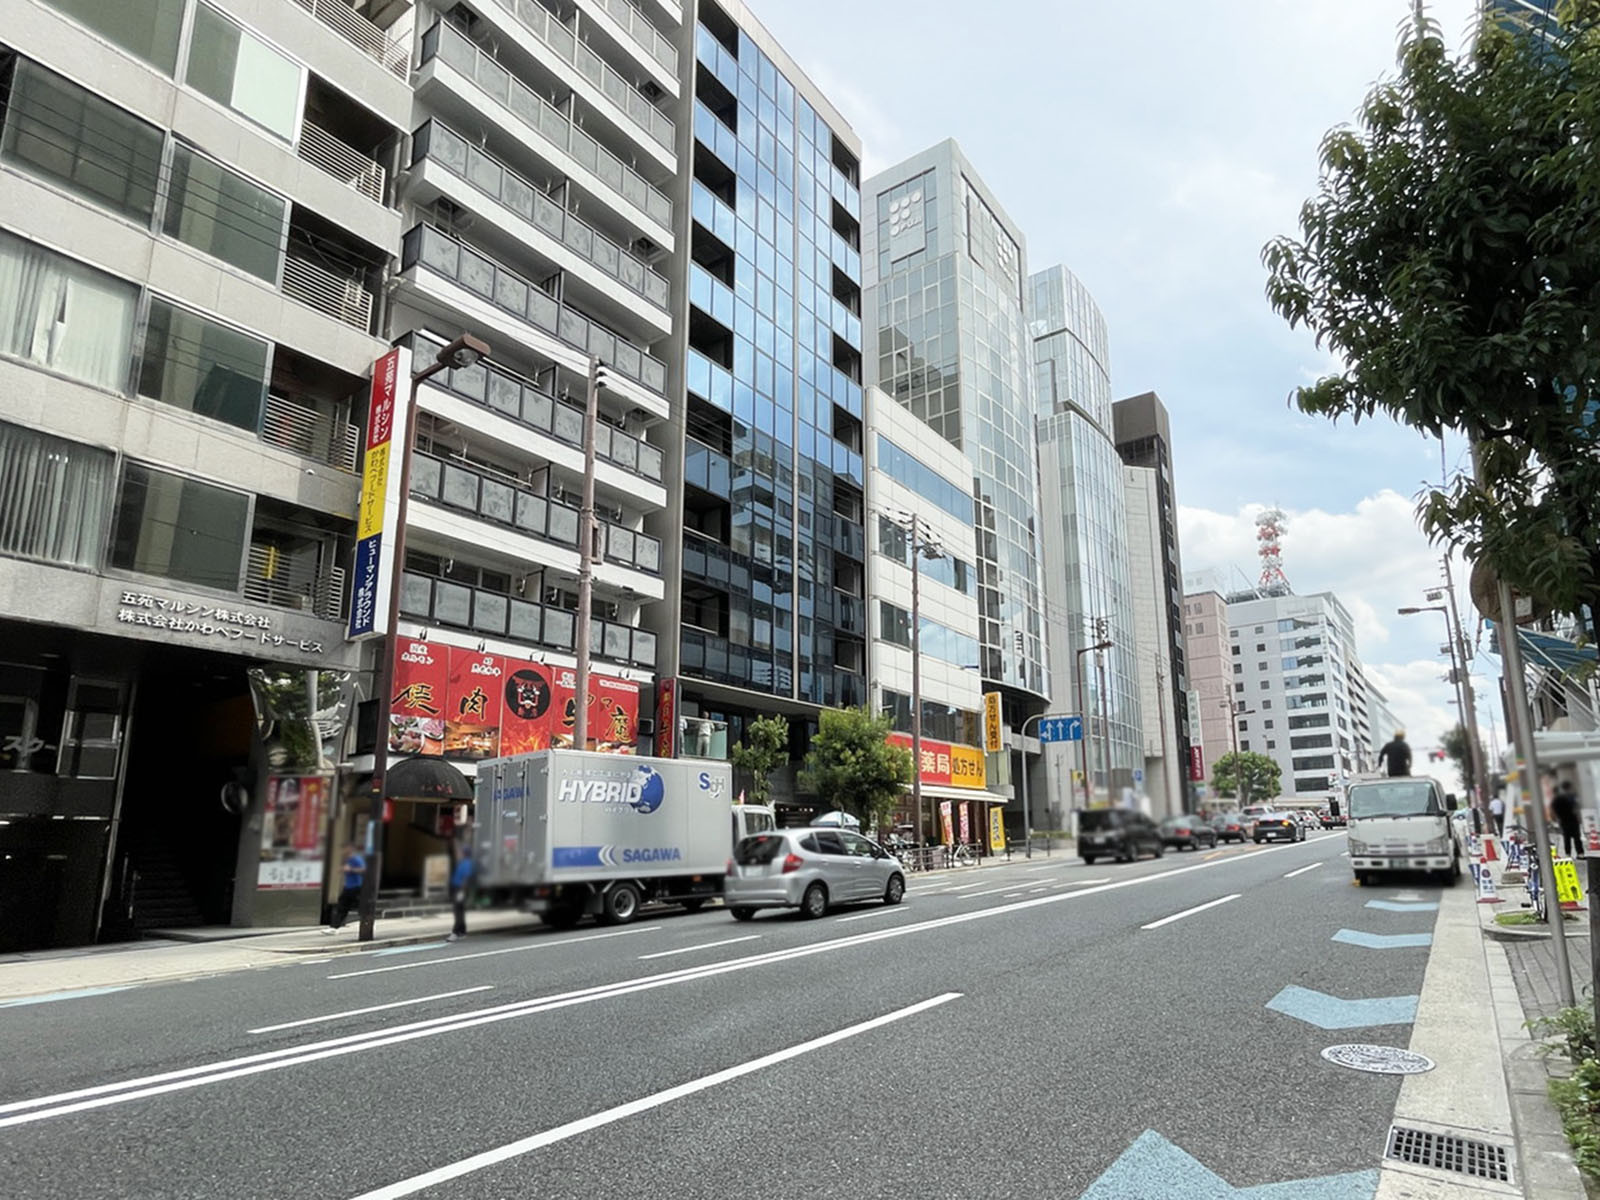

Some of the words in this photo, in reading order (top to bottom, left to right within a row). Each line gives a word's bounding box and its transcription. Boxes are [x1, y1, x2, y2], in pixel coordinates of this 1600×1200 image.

[121, 590, 272, 630] 五苑マルシン株式会社
[117, 608, 325, 653] 株式会社かわべフードサービス
[558, 779, 643, 804] HYBRID
[623, 848, 681, 863] SAGAWA
